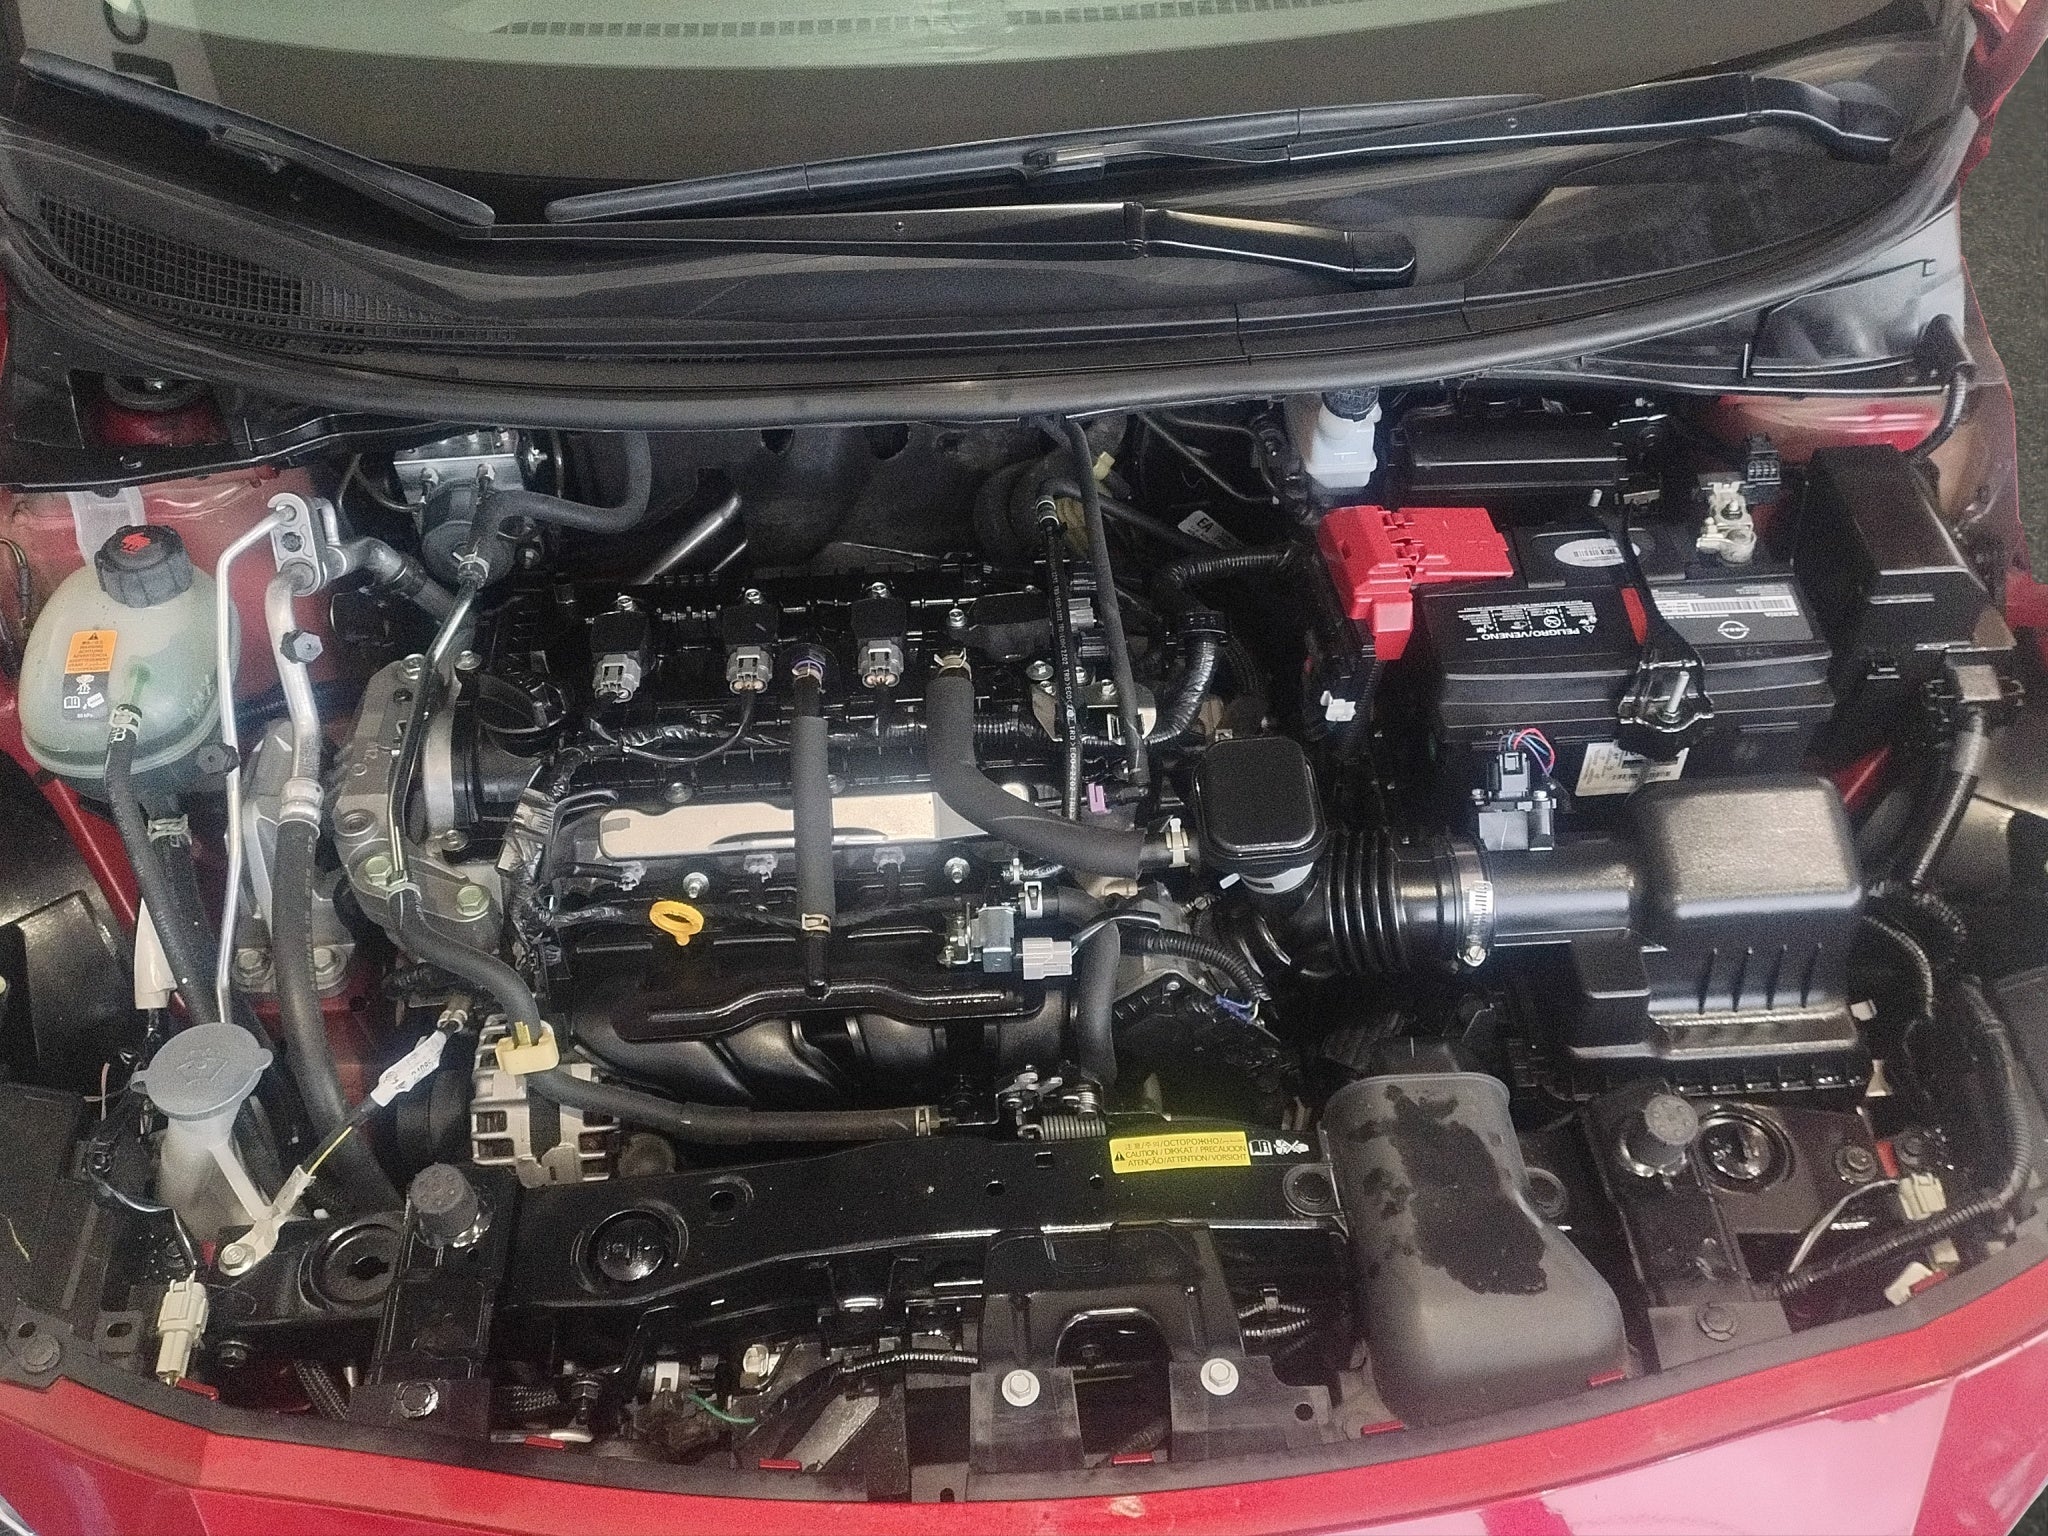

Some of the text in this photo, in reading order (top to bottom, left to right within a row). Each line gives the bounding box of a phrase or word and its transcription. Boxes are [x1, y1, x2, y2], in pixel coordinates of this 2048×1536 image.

[1481, 628, 1580, 640] PELIGRO/VENENO
[1125, 1149, 1158, 1159] CAUTION
[1164, 1146, 1193, 1155] DIKKAT
